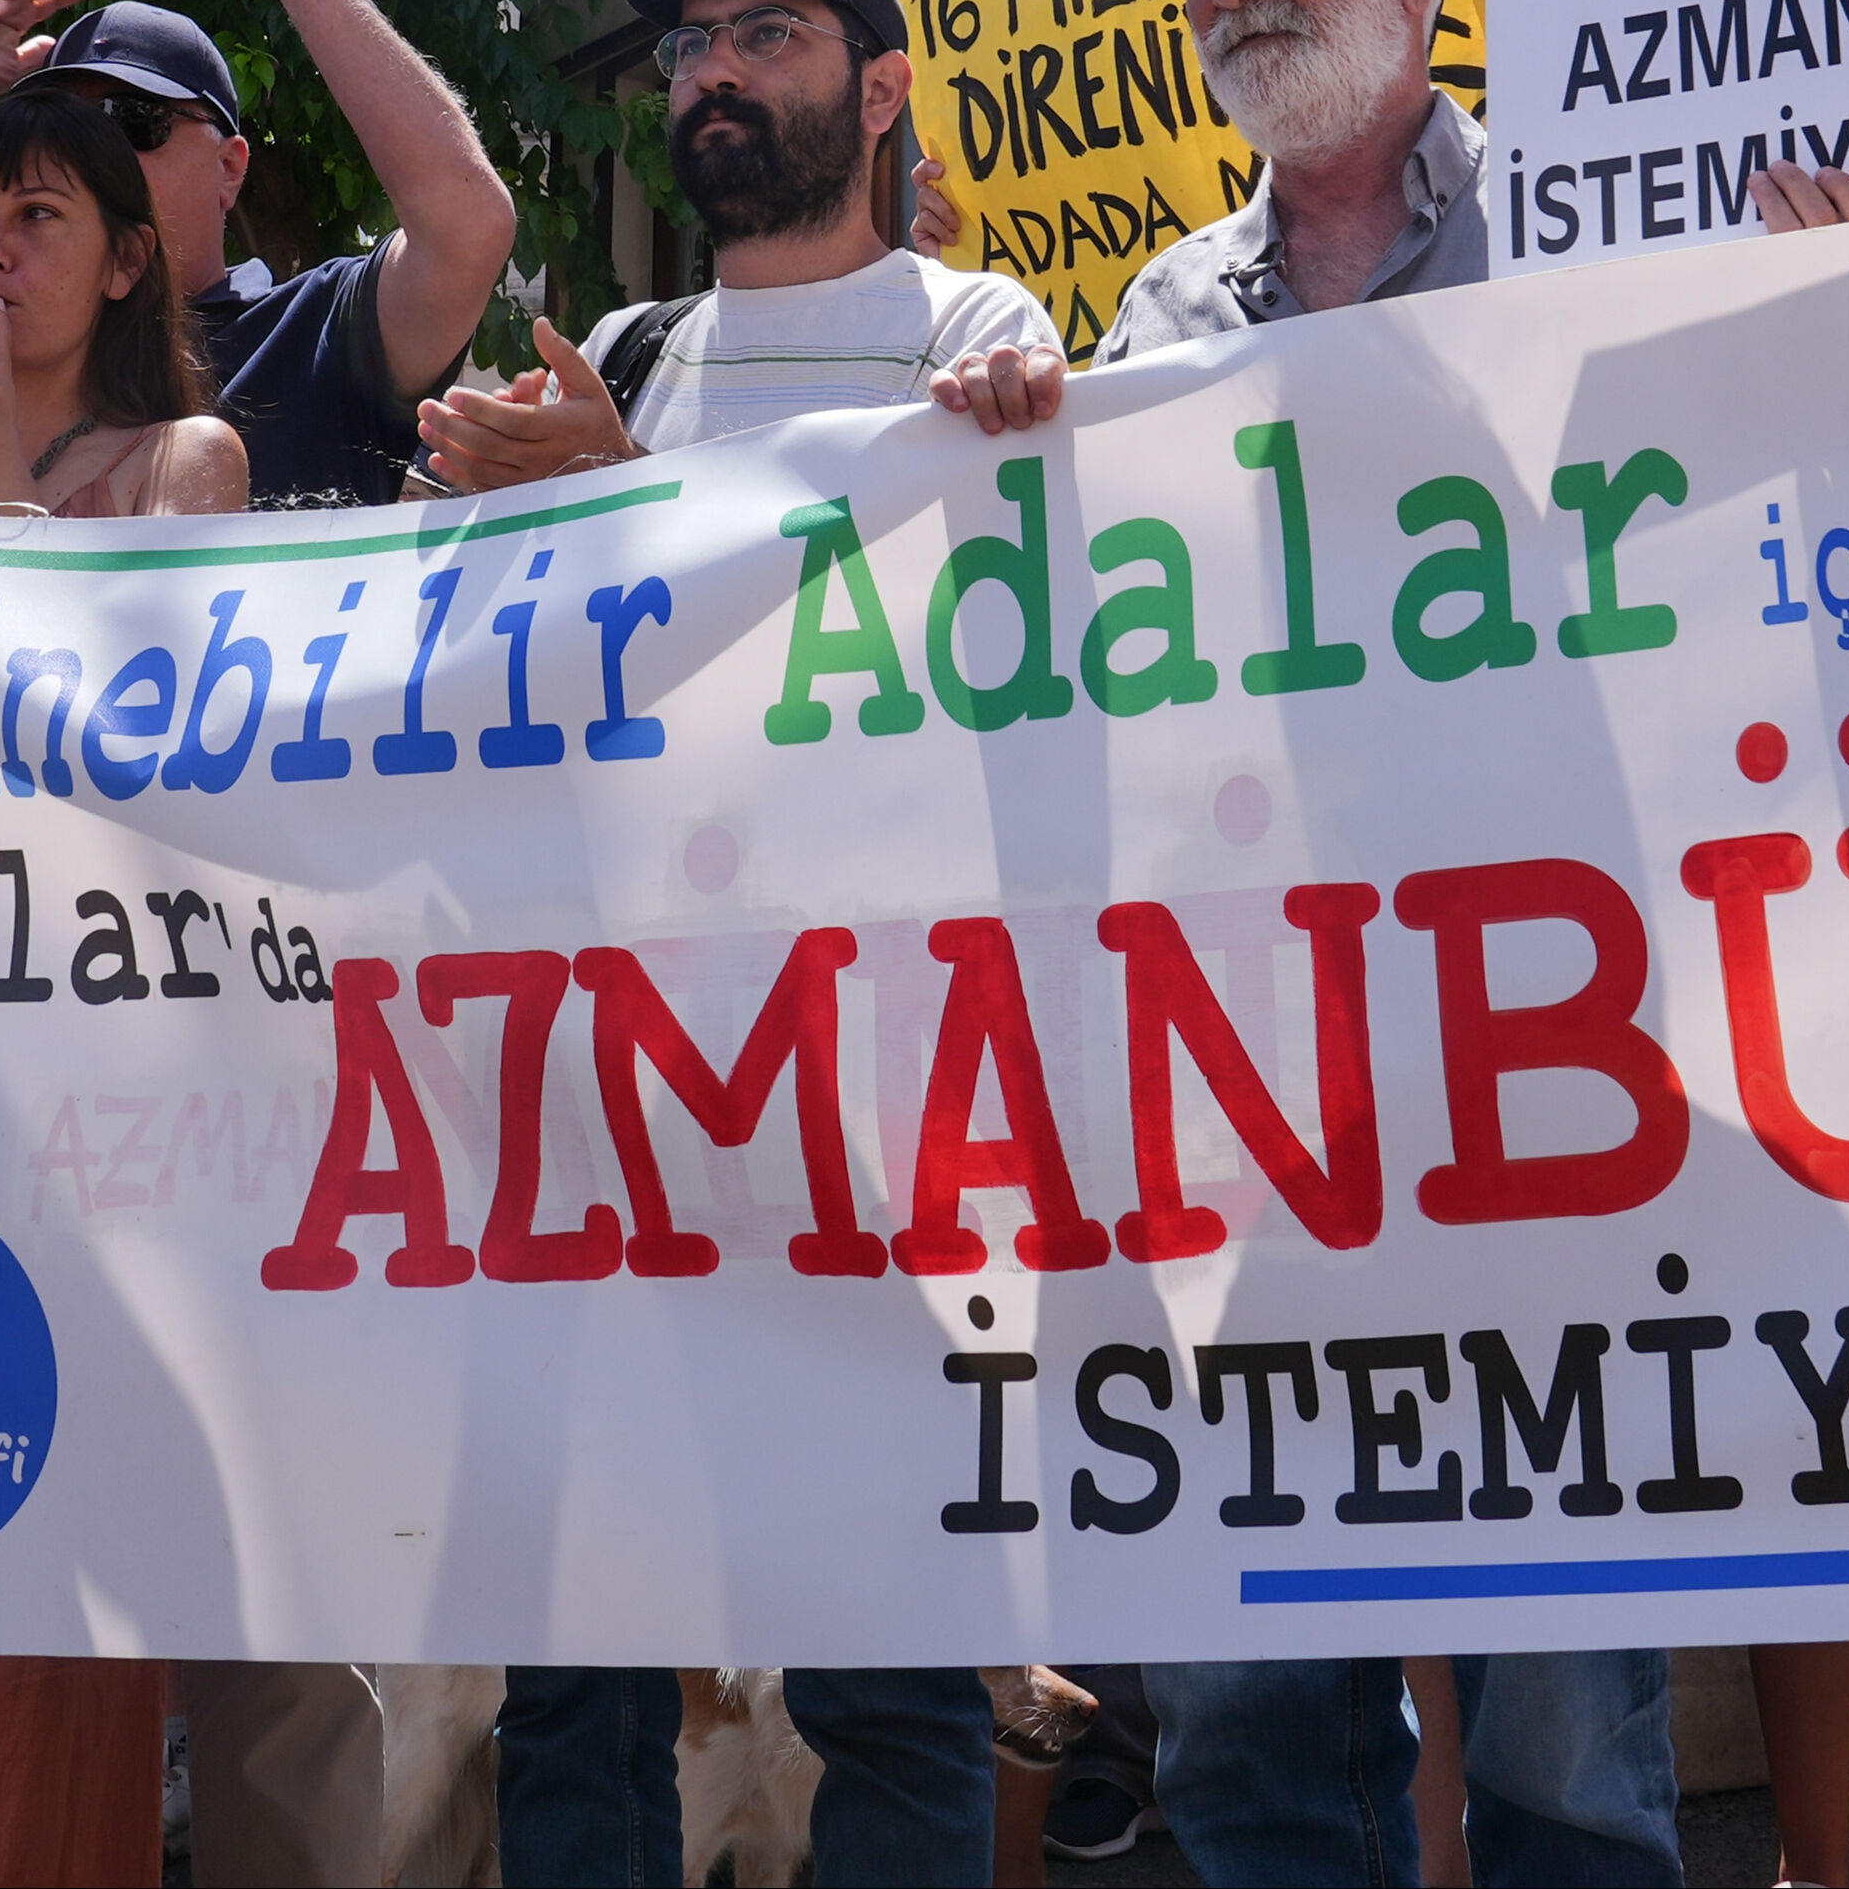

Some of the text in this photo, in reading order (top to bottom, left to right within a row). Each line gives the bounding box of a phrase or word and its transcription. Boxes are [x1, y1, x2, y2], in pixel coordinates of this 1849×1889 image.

[947, 2, 1230, 183] DİRENİ
[981, 176, 1192, 278] ADADA
[764, 418, 1689, 747] Adalar
